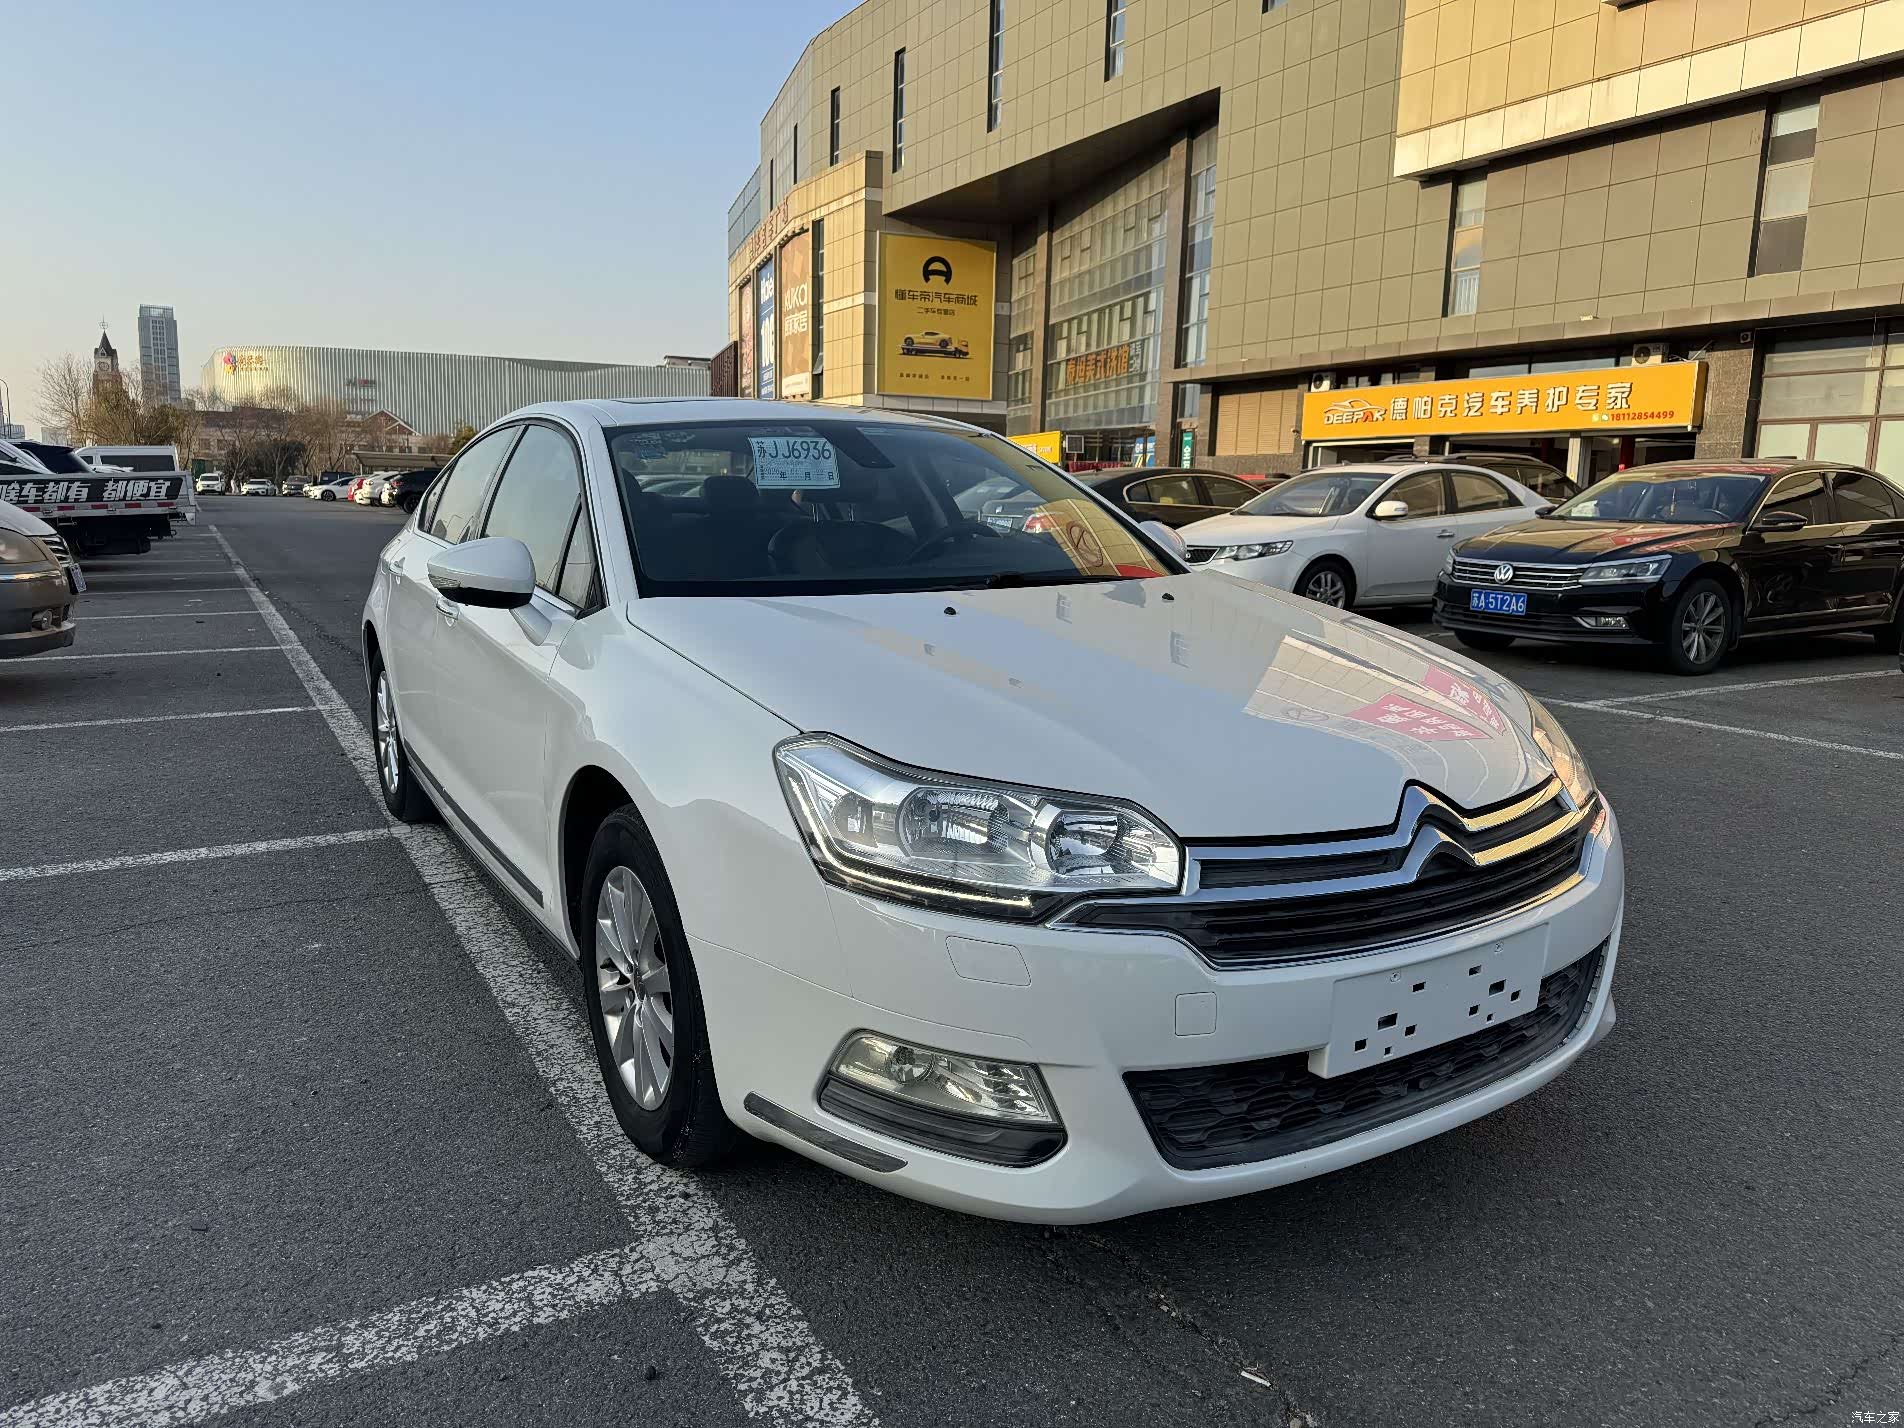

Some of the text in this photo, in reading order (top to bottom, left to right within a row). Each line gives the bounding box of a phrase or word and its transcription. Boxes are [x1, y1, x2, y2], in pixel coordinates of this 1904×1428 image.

[761, 273, 774, 305] Haie
[895, 288, 978, 306] 懂车帝汽车商城
[1323, 382, 1633, 425] DEEPAK 德帕克汽车养护专家
[1611, 410, 1675, 422] 18112854499
[103, 478, 170, 501] 都便宜
